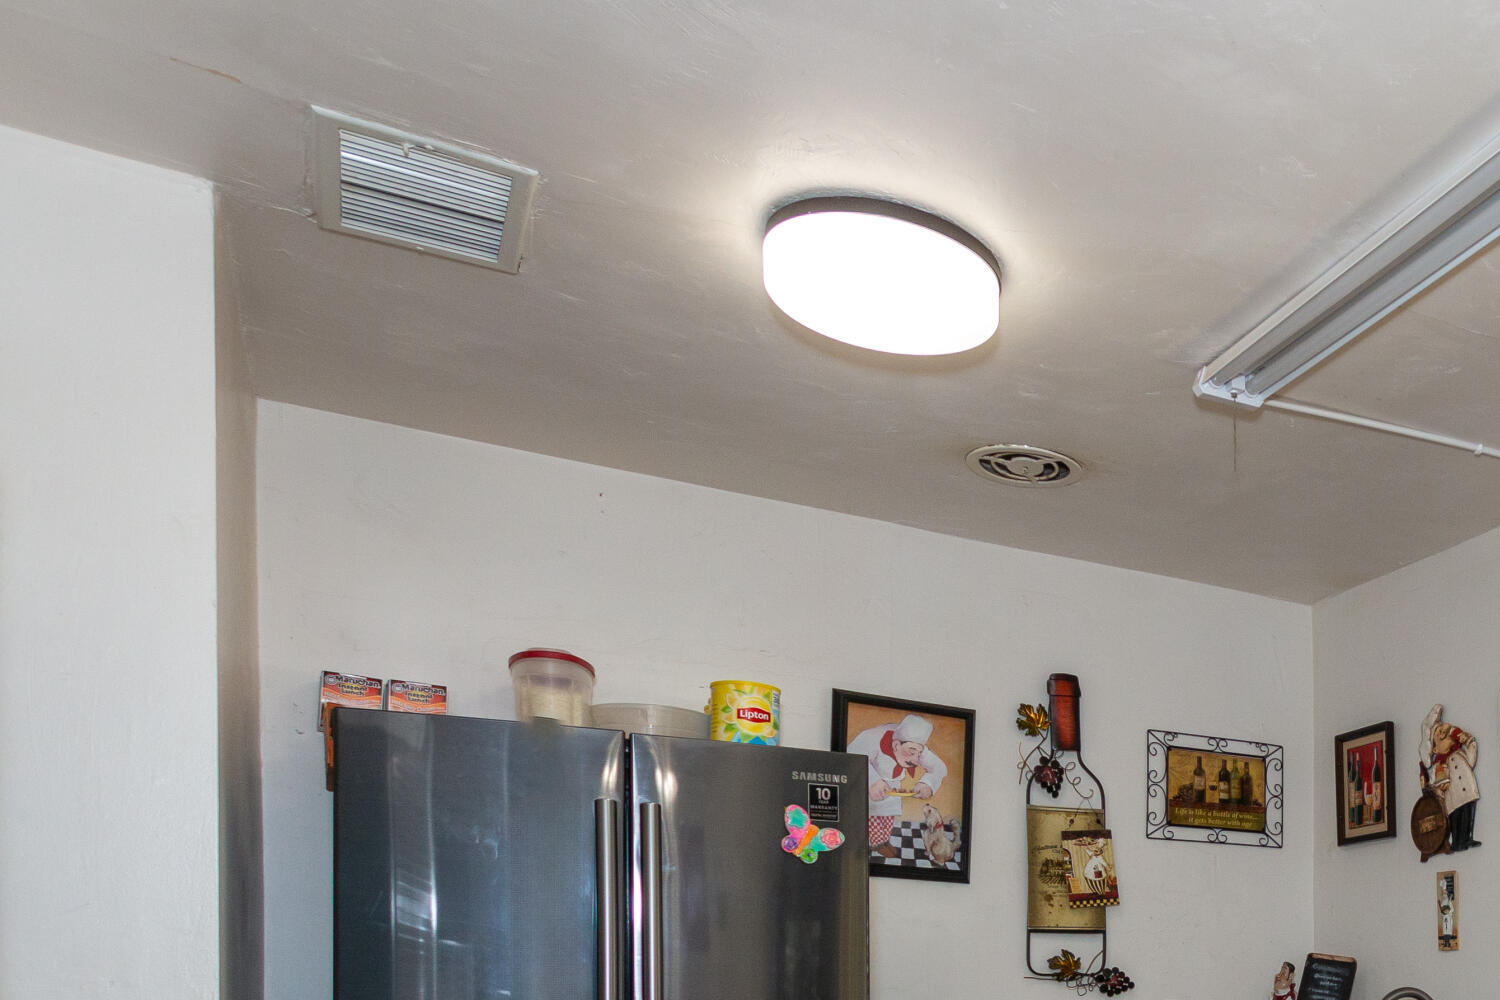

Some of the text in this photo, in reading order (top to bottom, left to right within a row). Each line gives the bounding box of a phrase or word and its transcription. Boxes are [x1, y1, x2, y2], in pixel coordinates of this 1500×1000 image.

[335, 674, 380, 688] Maruchan
[401, 682, 445, 695] Maruchan
[739, 709, 770, 721] Lipton
[791, 770, 848, 784] SAMSUNG
[815, 787, 831, 800] 10
